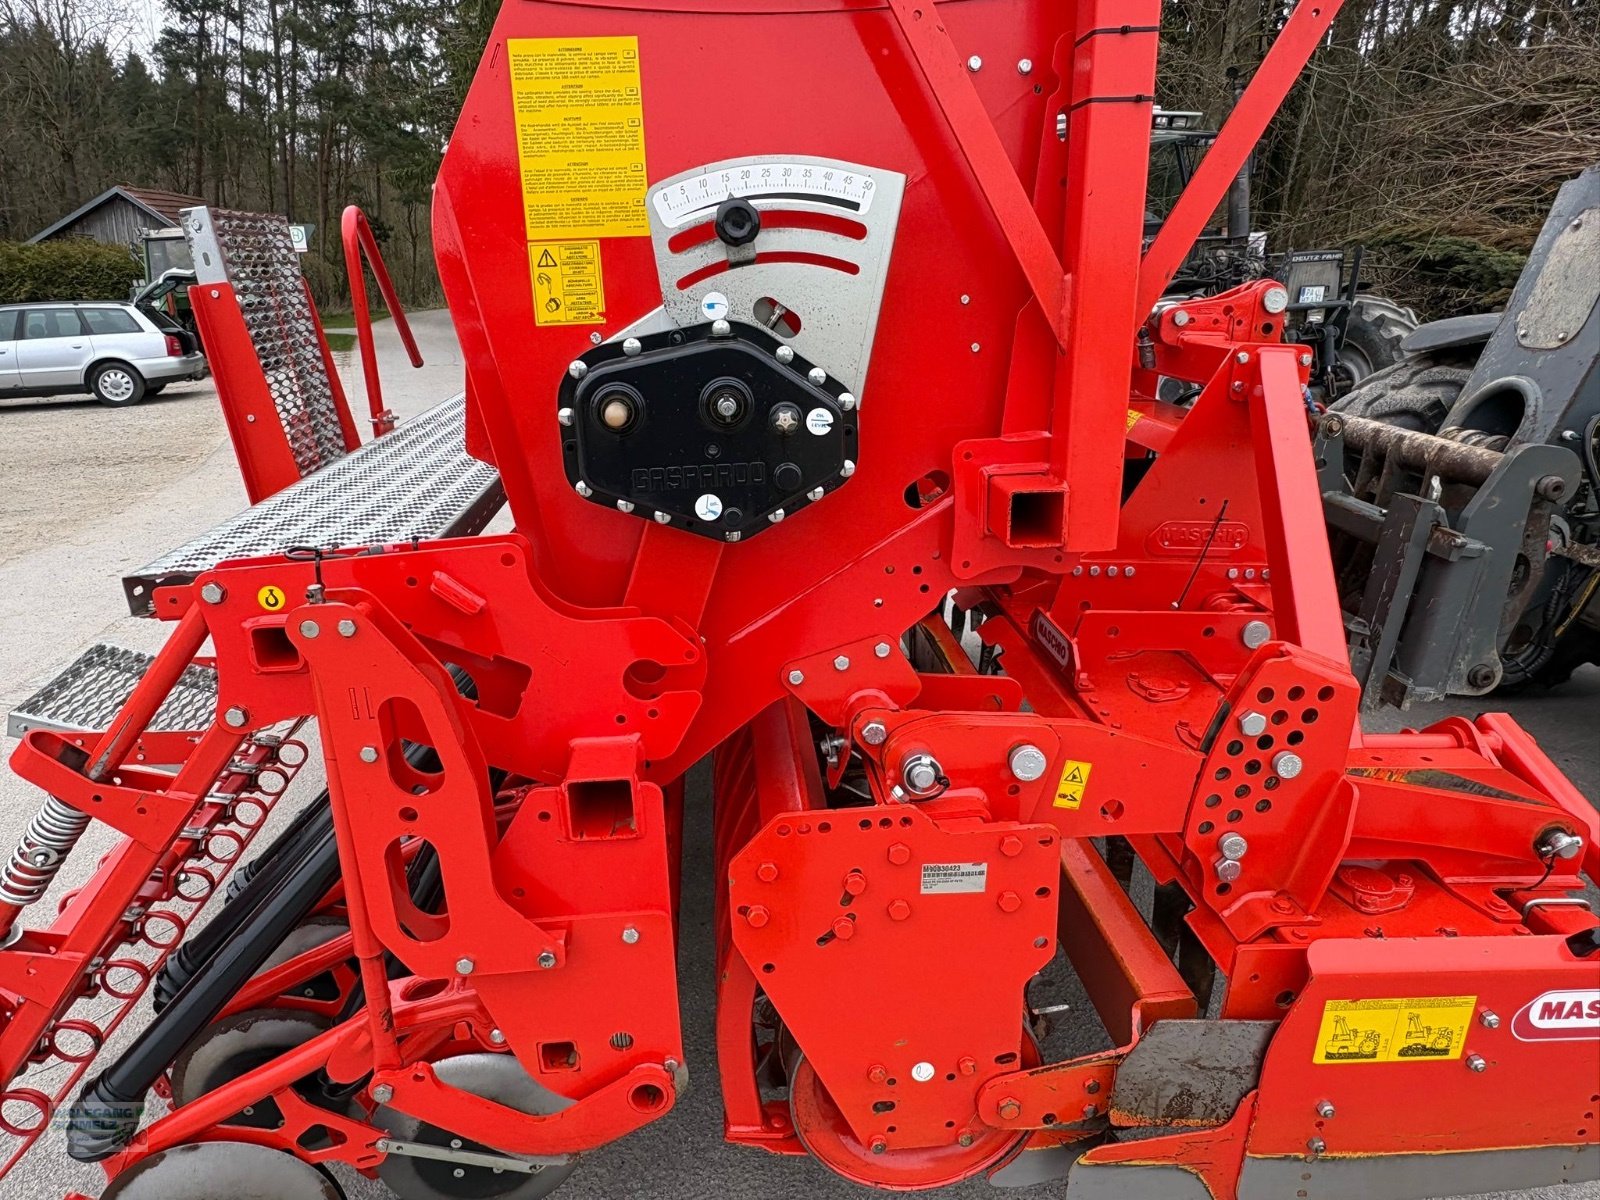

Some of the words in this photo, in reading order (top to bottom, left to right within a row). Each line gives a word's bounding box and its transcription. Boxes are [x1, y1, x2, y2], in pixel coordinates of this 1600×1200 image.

[662, 192, 669, 202] 0
[680, 185, 686, 195] 5
[698, 179, 708, 189] 10
[721, 173, 731, 183] 15
[741, 170, 751, 180] 20
[761, 168, 771, 178] 25
[782, 167, 792, 177] 30
[802, 169, 813, 178] 35
[823, 171, 834, 181] 40
[843, 175, 853, 185] 45
[862, 181, 874, 191] 50
[631, 461, 766, 490] GASPARDO
[1538, 1000, 1600, 1021] MAS
